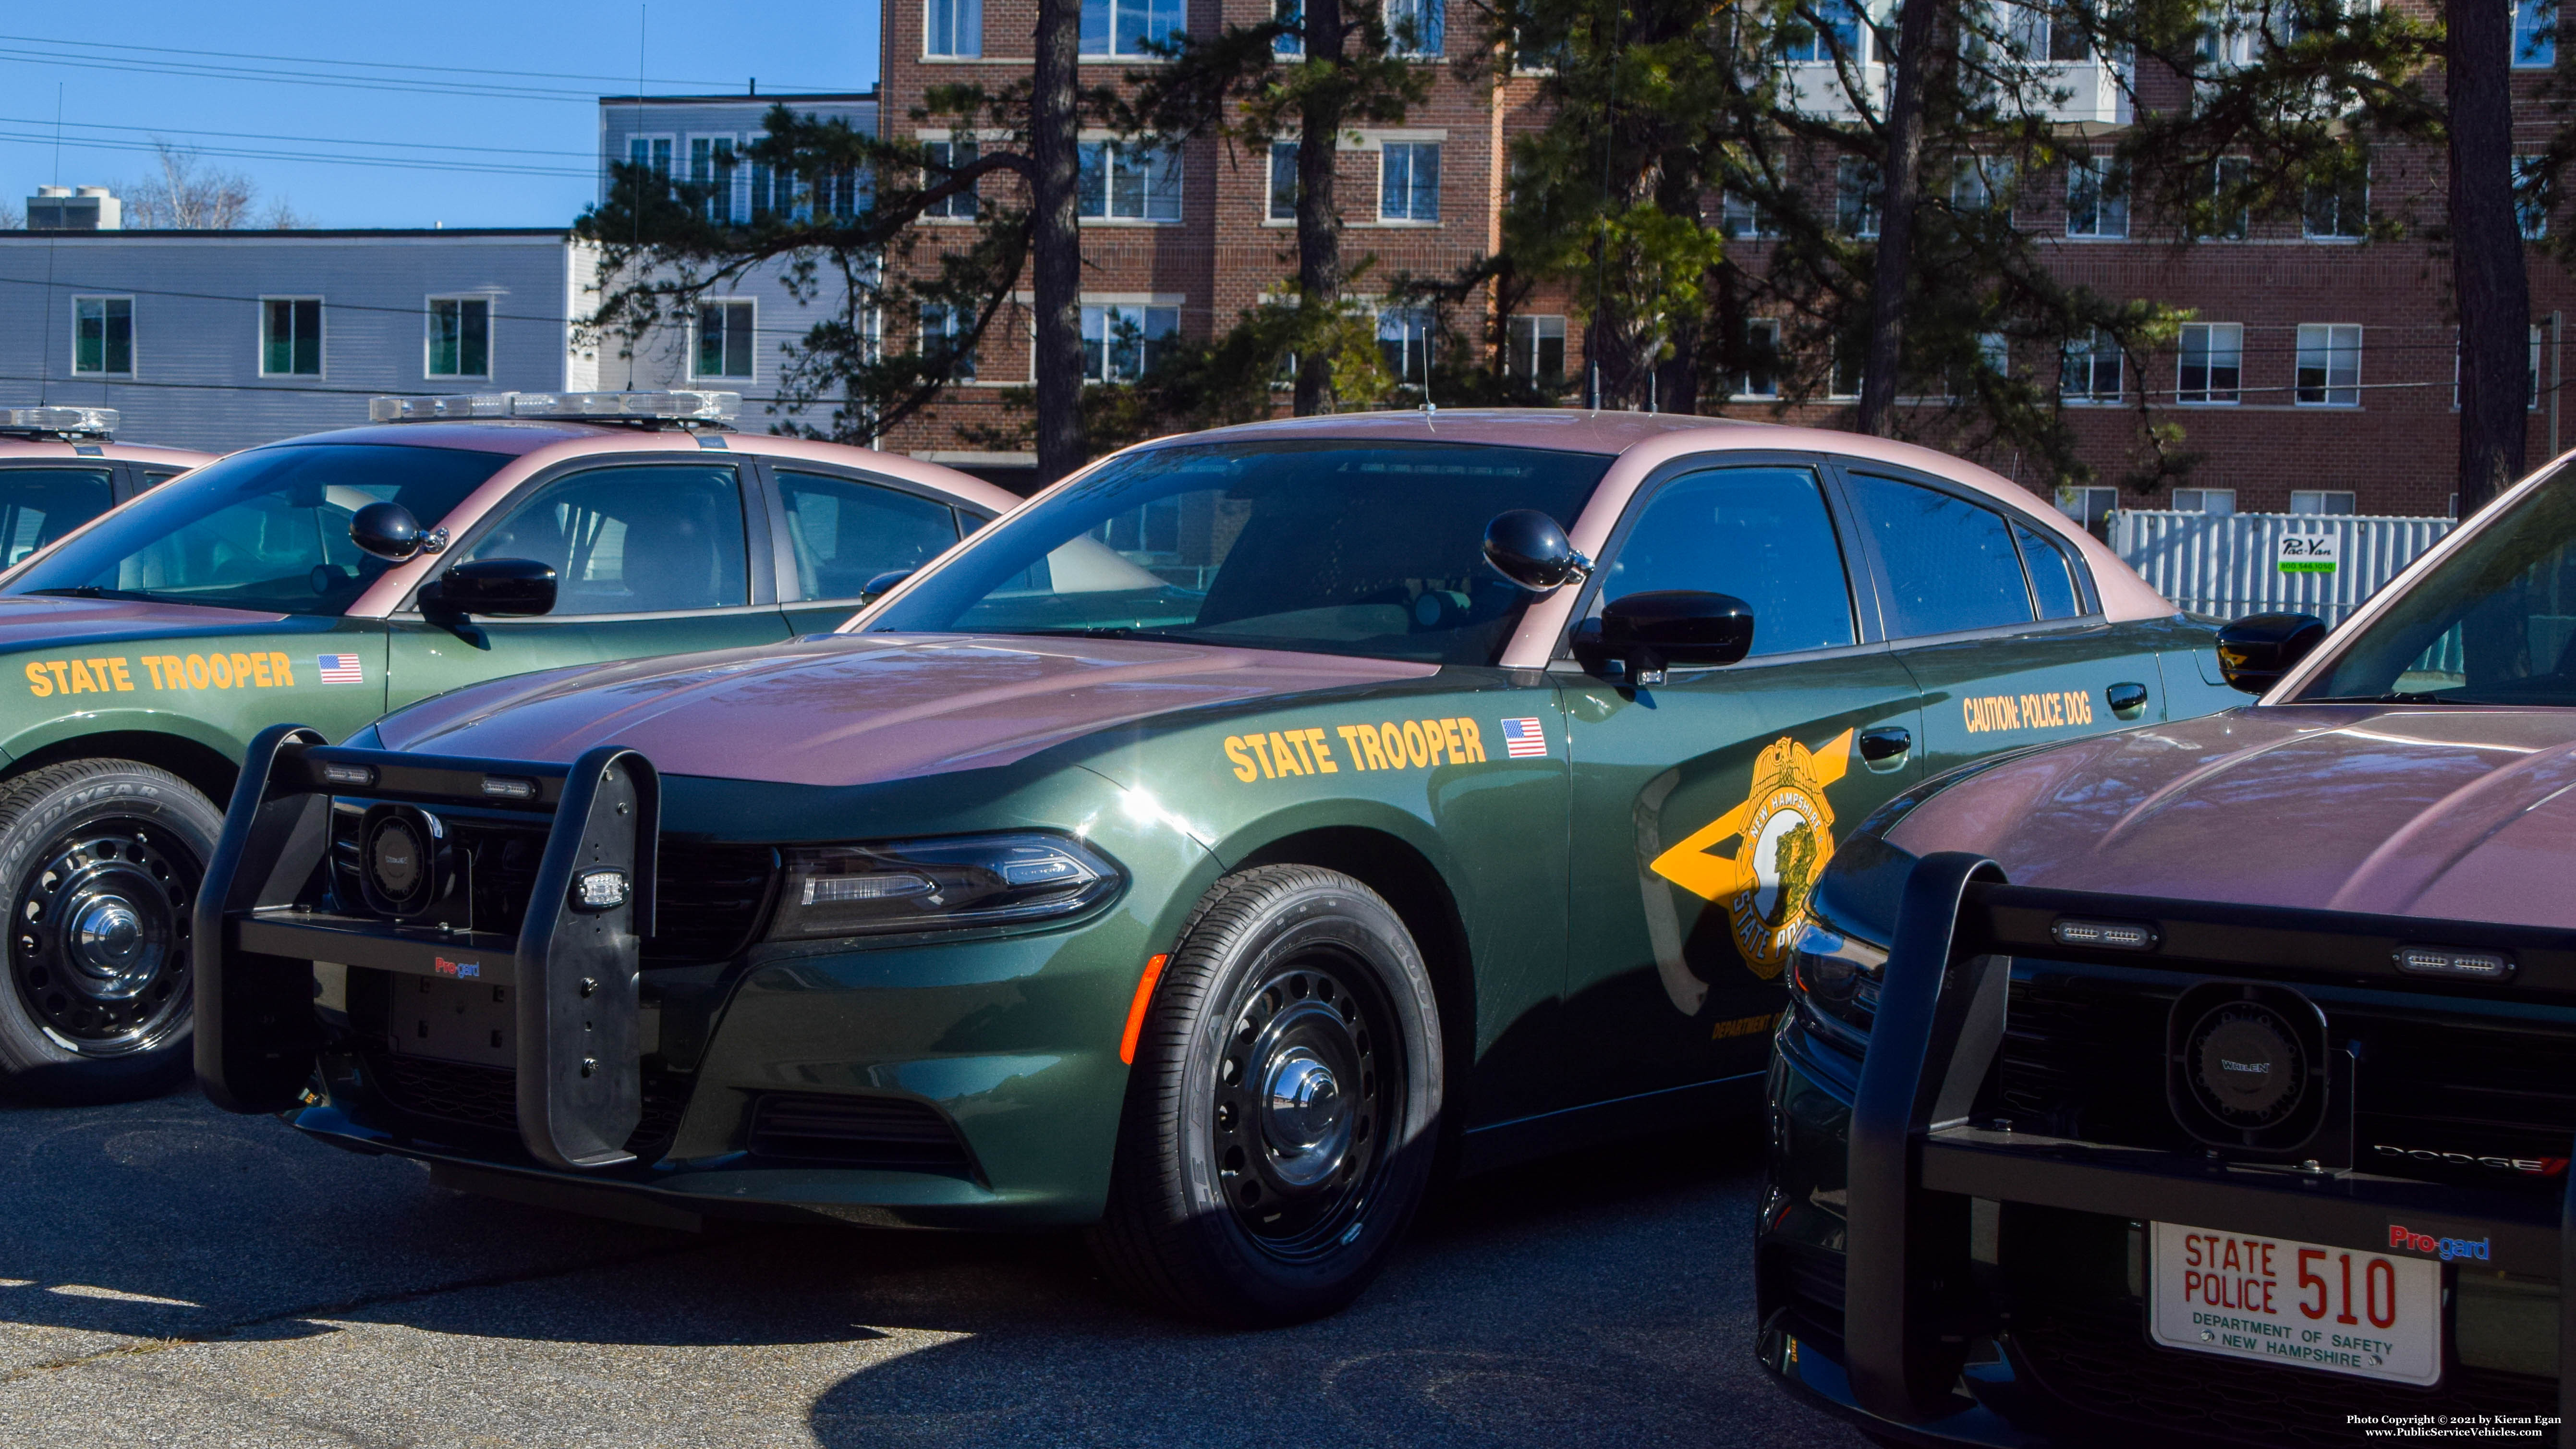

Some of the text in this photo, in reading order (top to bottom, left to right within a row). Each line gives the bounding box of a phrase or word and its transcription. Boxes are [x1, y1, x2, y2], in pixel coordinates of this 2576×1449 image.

[2283, 538, 2331, 555] Pac-Van
[25, 652, 294, 697] STATE TROOPER
[1964, 690, 2092, 733] CAUTION: POLICE DOG
[1224, 717, 1486, 782] STATE TROOPER
[1750, 791, 1821, 838] NEW HAMPSHIRE
[1733, 891, 1772, 959] STATE
[1711, 1013, 1772, 1041] DEPARTMENT
[2221, 1059, 2270, 1073] WHELEN
[2374, 1145, 2543, 1171] DODGE
[2389, 1225, 2489, 1261] Pro-gard
[2186, 1235, 2396, 1329] STATE 510
[2186, 1270, 2277, 1315] POLICE
[2193, 1312, 2393, 1356] DEPARTMENT OF SAFETY
[2222, 1333, 2362, 1367] NEW HAMPSHIRE
